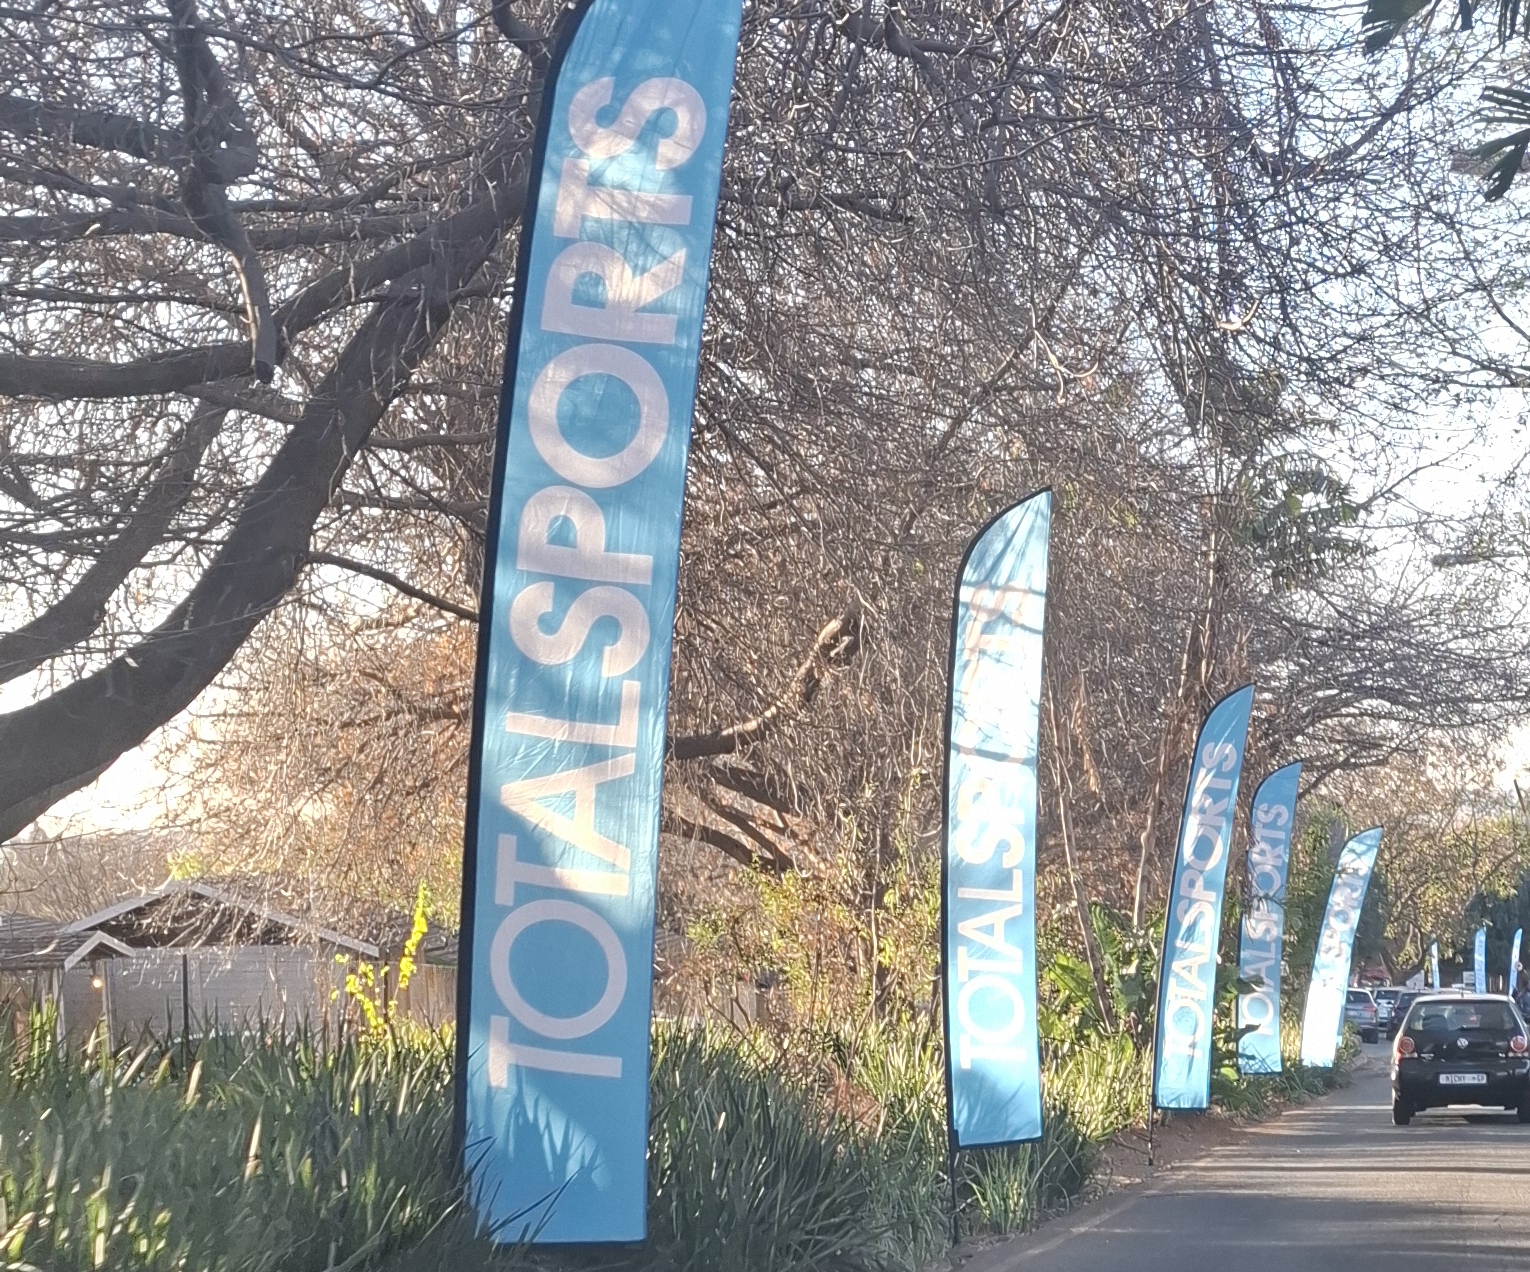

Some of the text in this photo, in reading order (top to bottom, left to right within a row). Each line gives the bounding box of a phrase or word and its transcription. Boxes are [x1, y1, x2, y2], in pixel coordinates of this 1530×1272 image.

[488, 76, 708, 1090] TOTALSPORTS
[956, 581, 1033, 1070] TOTALSPOTS
[1163, 741, 1237, 1059] TOTALSPORTS
